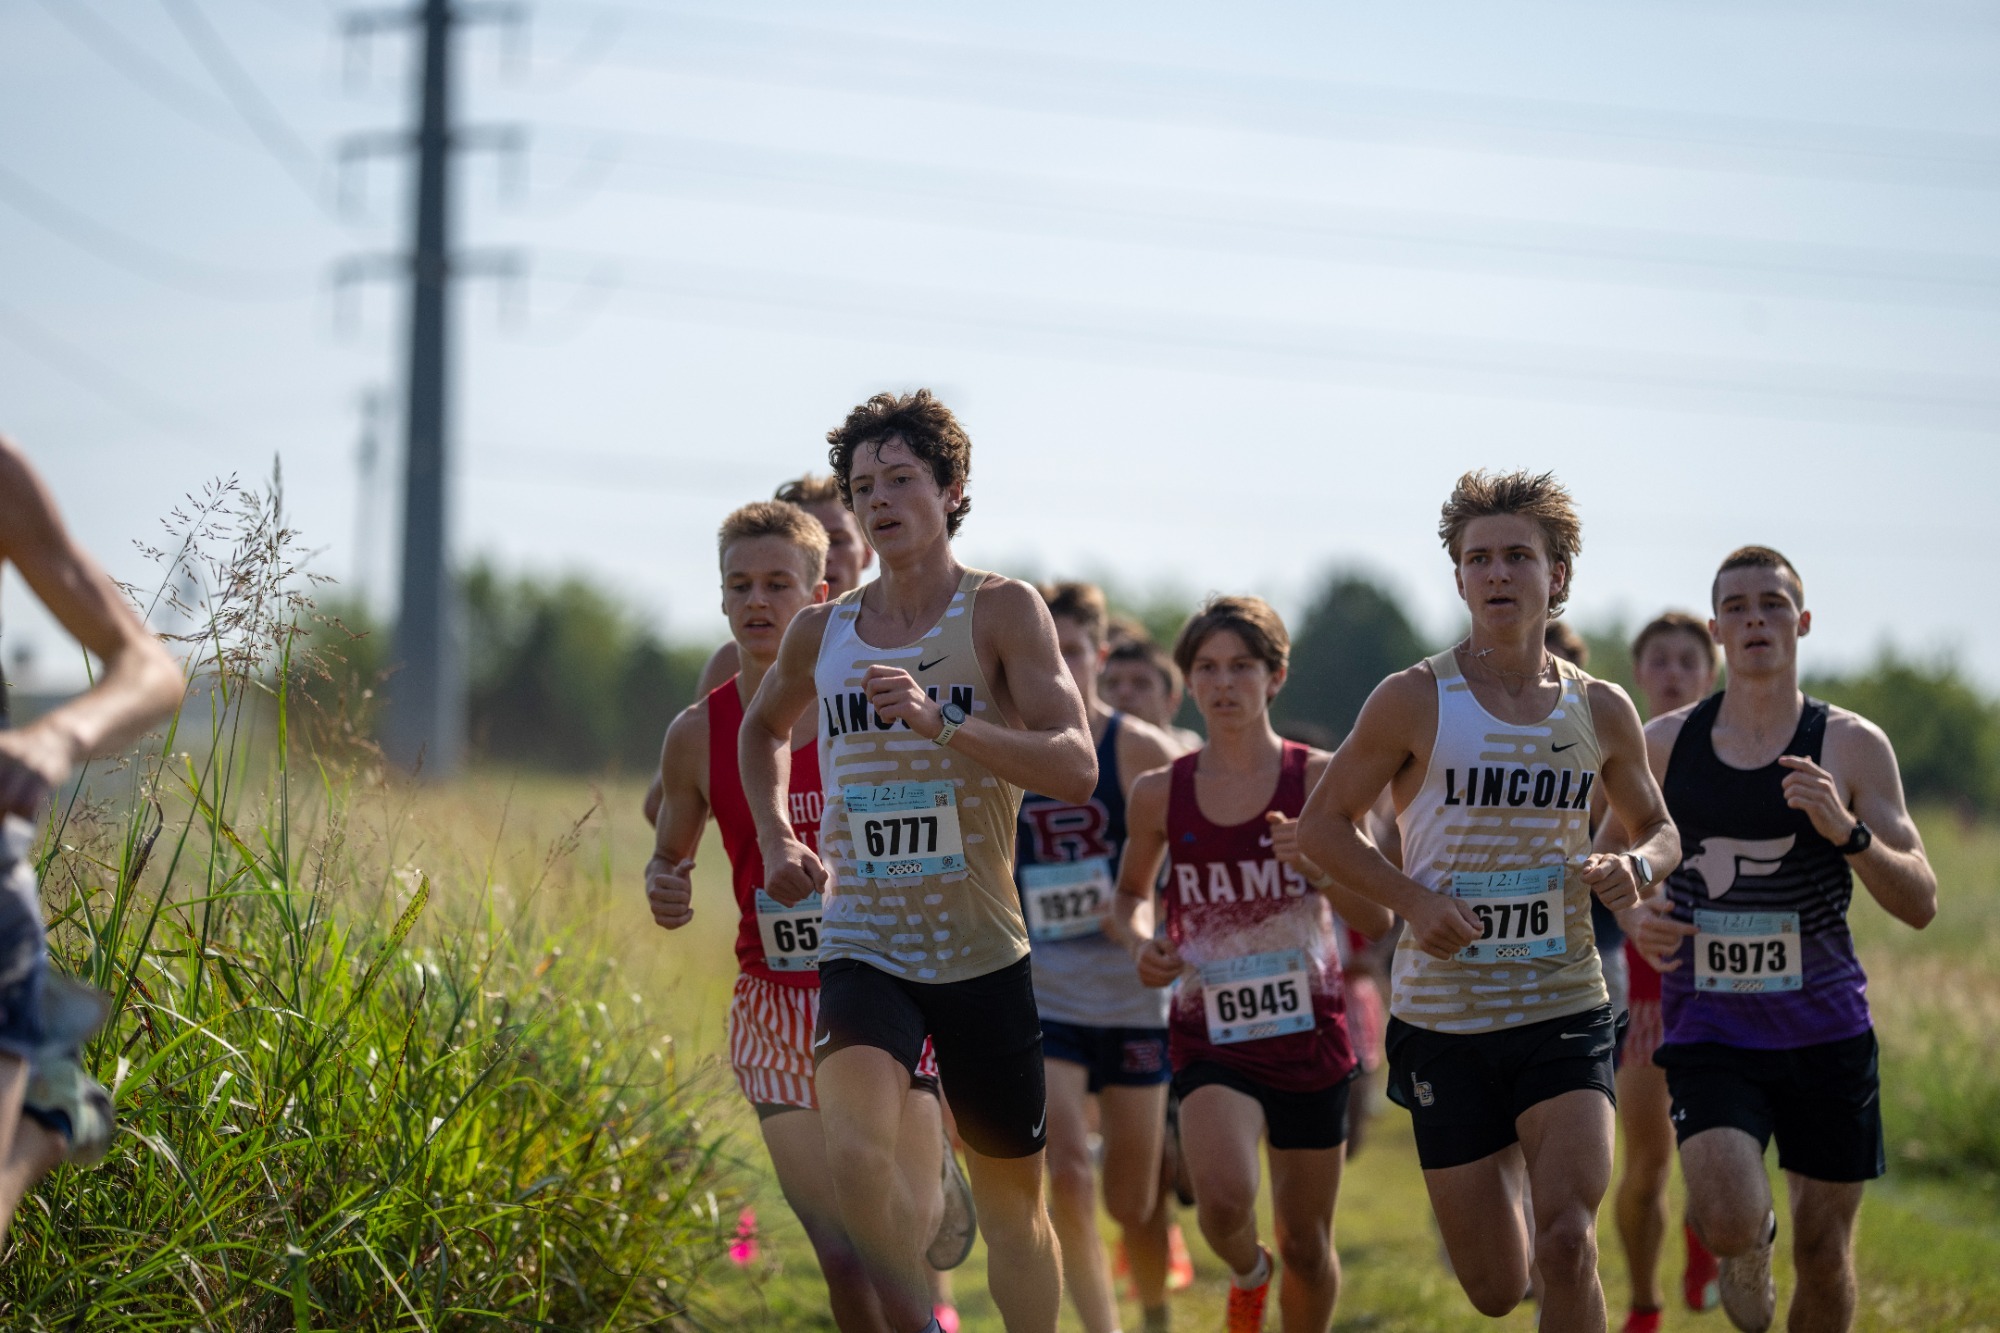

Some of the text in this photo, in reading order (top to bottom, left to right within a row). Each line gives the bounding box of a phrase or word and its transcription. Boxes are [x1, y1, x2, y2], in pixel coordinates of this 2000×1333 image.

[824, 687, 973, 737] LINN
[864, 816, 938, 857] 6777
[1021, 801, 1117, 863] R
[1176, 859, 1307, 904] RAMS
[1472, 900, 1549, 939] 6776
[1708, 941, 1787, 975] 6973
[1217, 979, 1298, 1023] 6945
